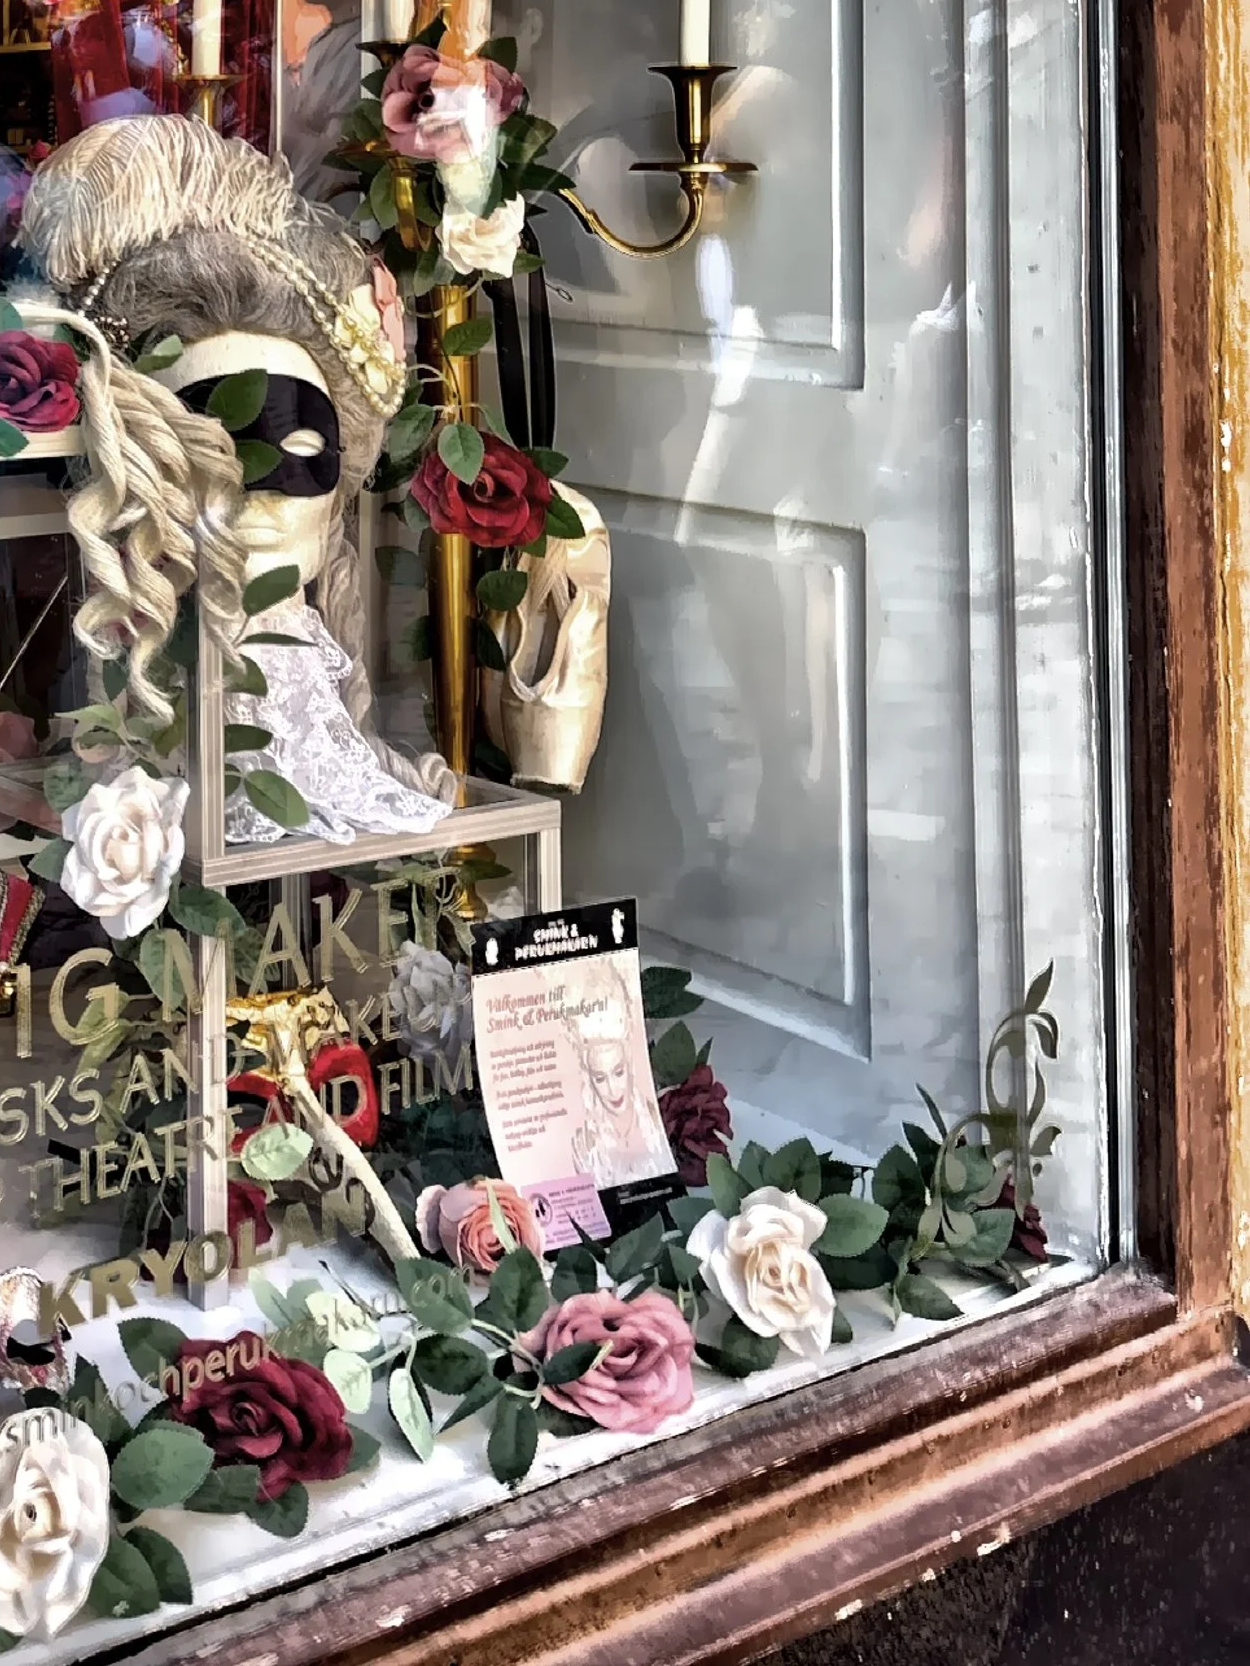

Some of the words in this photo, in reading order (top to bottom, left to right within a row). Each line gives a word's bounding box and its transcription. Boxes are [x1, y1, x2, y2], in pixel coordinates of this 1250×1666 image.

[160, 866, 477, 1022] MAKER
[376, 1043, 474, 1116] FILM
[38, 1176, 367, 1336] KRYOLAN
